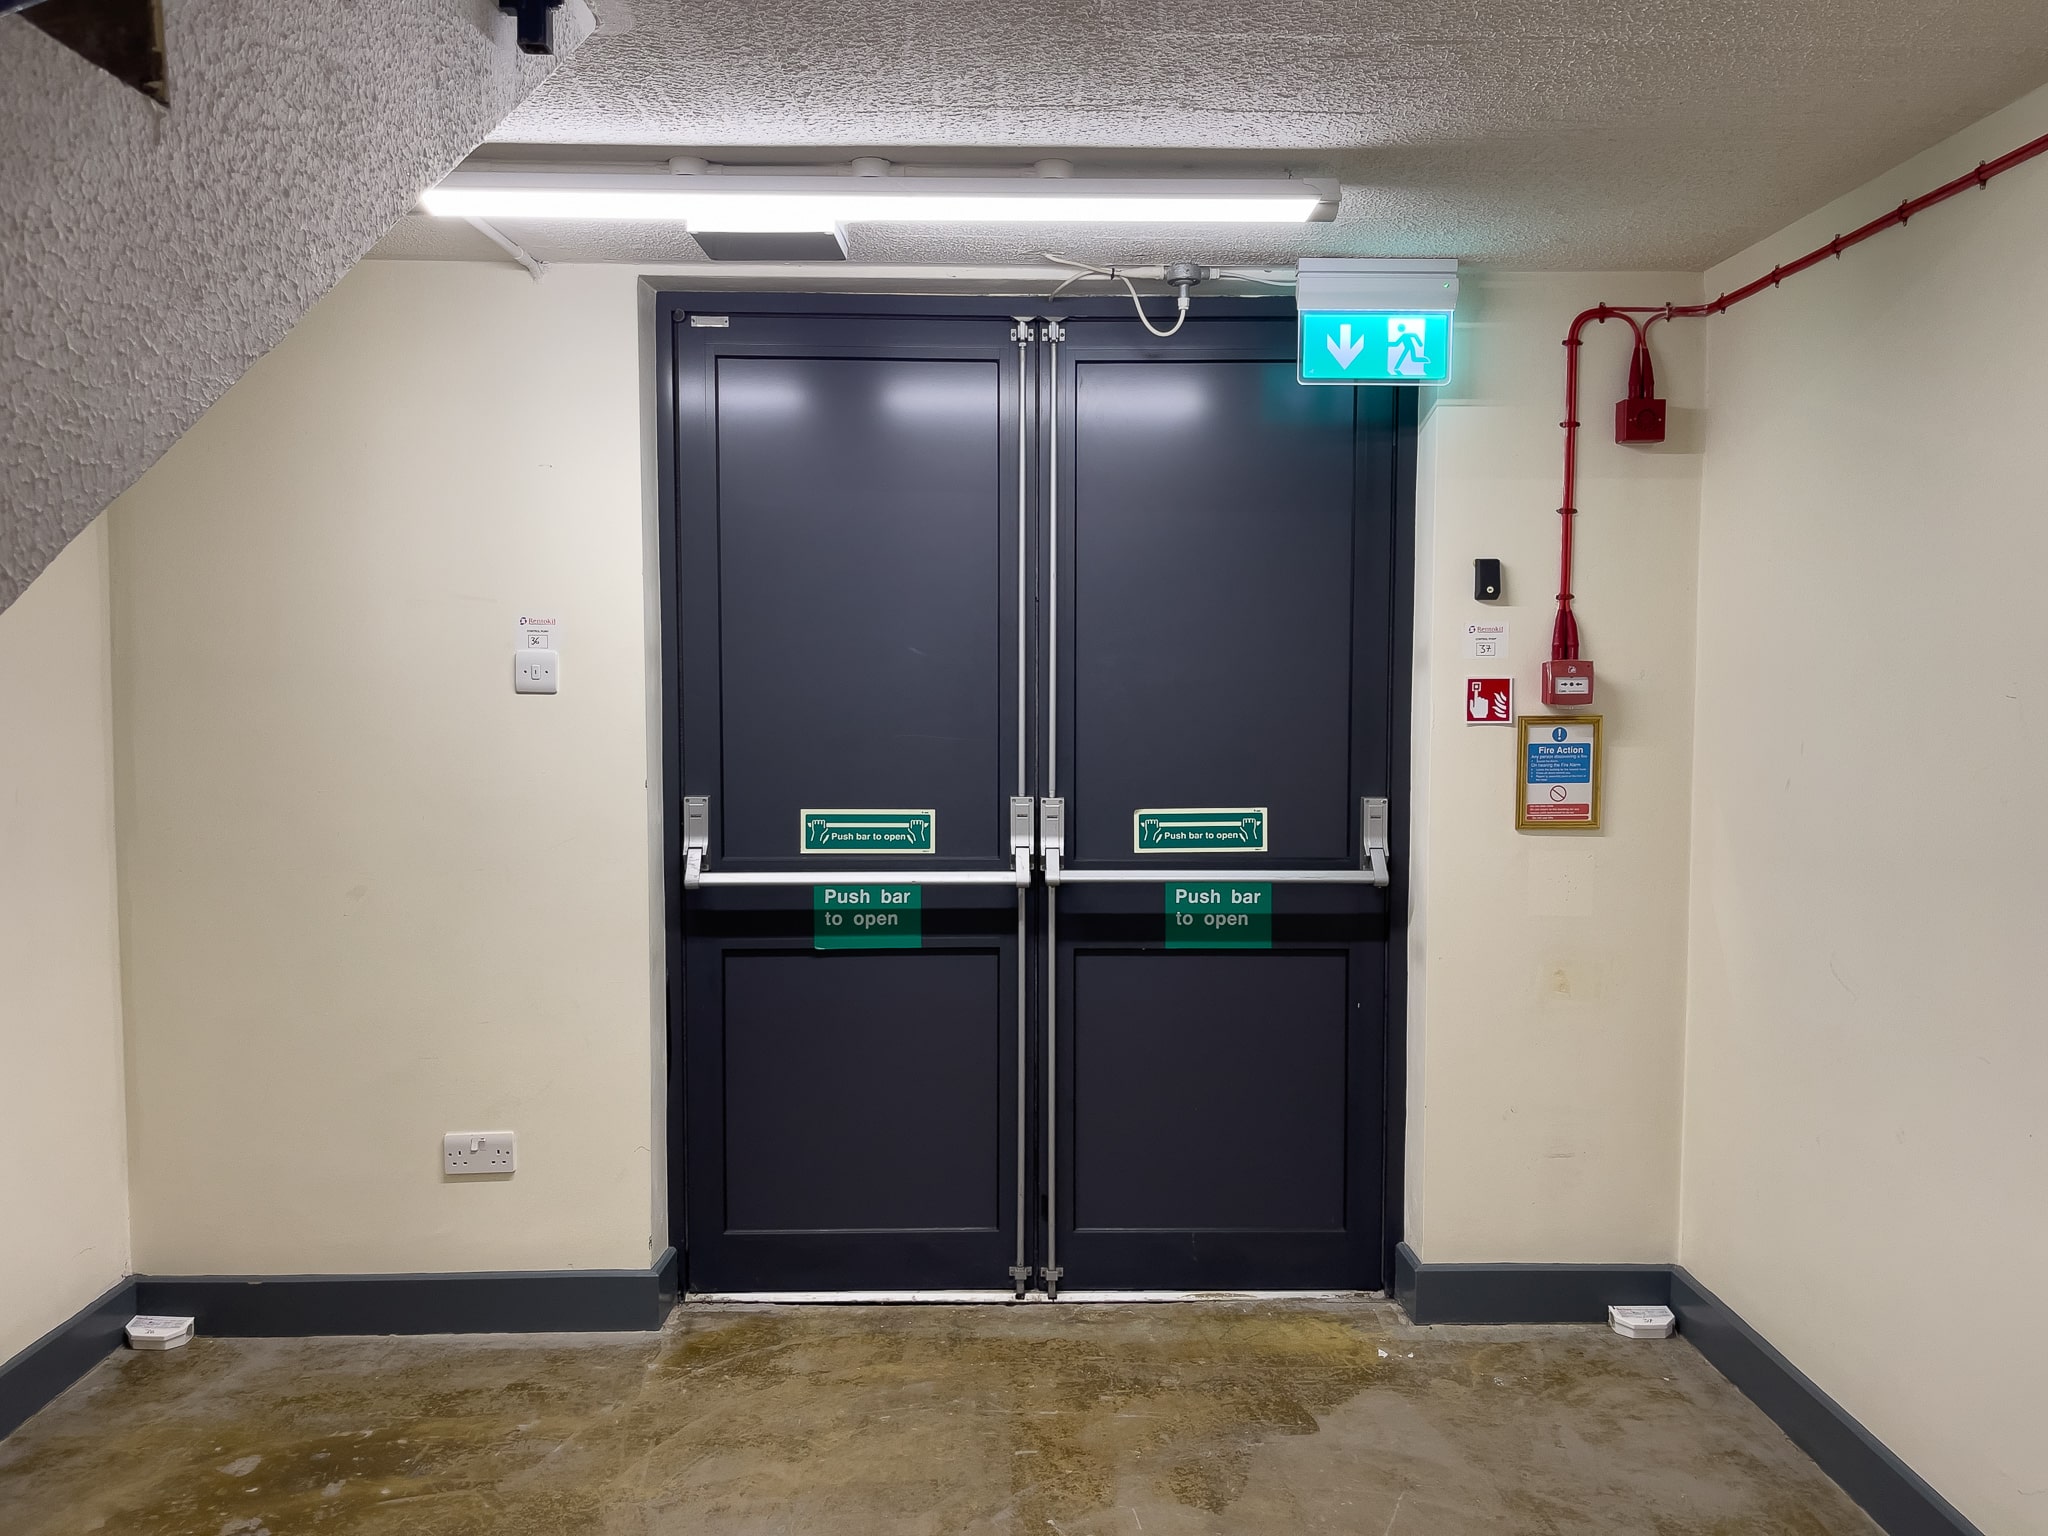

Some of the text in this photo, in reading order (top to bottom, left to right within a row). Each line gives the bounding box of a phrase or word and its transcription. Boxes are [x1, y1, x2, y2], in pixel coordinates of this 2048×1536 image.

[530, 636, 540, 645] 36
[1479, 644, 1491, 653] 37
[1556, 745, 1584, 754] Action
[831, 832, 906, 842] Push bar to open
[1164, 832, 1187, 840] Push
[1188, 831, 1203, 840] bar
[1216, 833, 1239, 841] open
[824, 888, 911, 904] Push bar
[1175, 888, 1262, 904] Push bar
[825, 911, 898, 930] to open
[1176, 911, 1249, 930] to open
